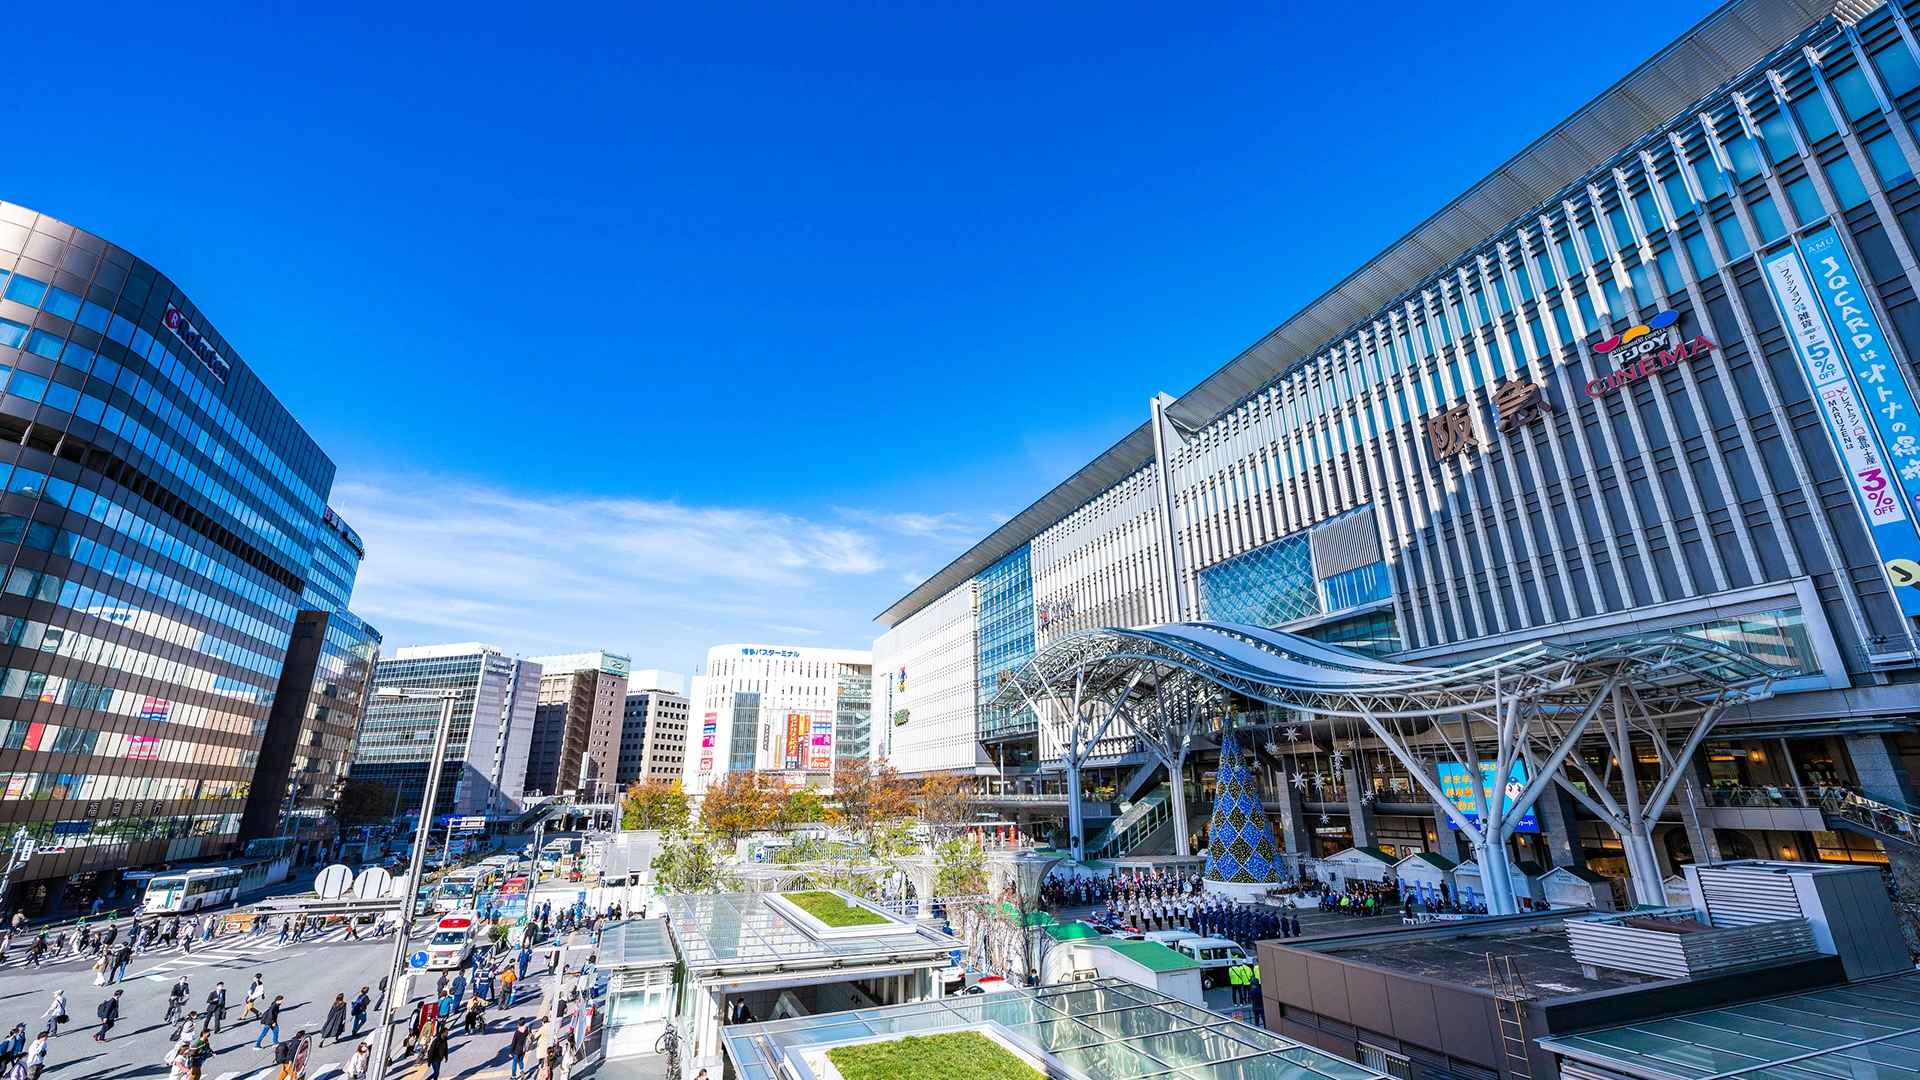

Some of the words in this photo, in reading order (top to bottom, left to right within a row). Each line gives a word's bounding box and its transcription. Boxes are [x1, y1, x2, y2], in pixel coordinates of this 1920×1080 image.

[1808, 236, 1834, 254] AMU
[176, 318, 229, 382] Rakuten
[1585, 334, 1717, 397] CINEMA
[1818, 370, 1837, 381] OFF
[1427, 379, 1552, 461] 阪急
[1873, 504, 1896, 516] OFF
[741, 647, 800, 658] 博多バスターミナル
